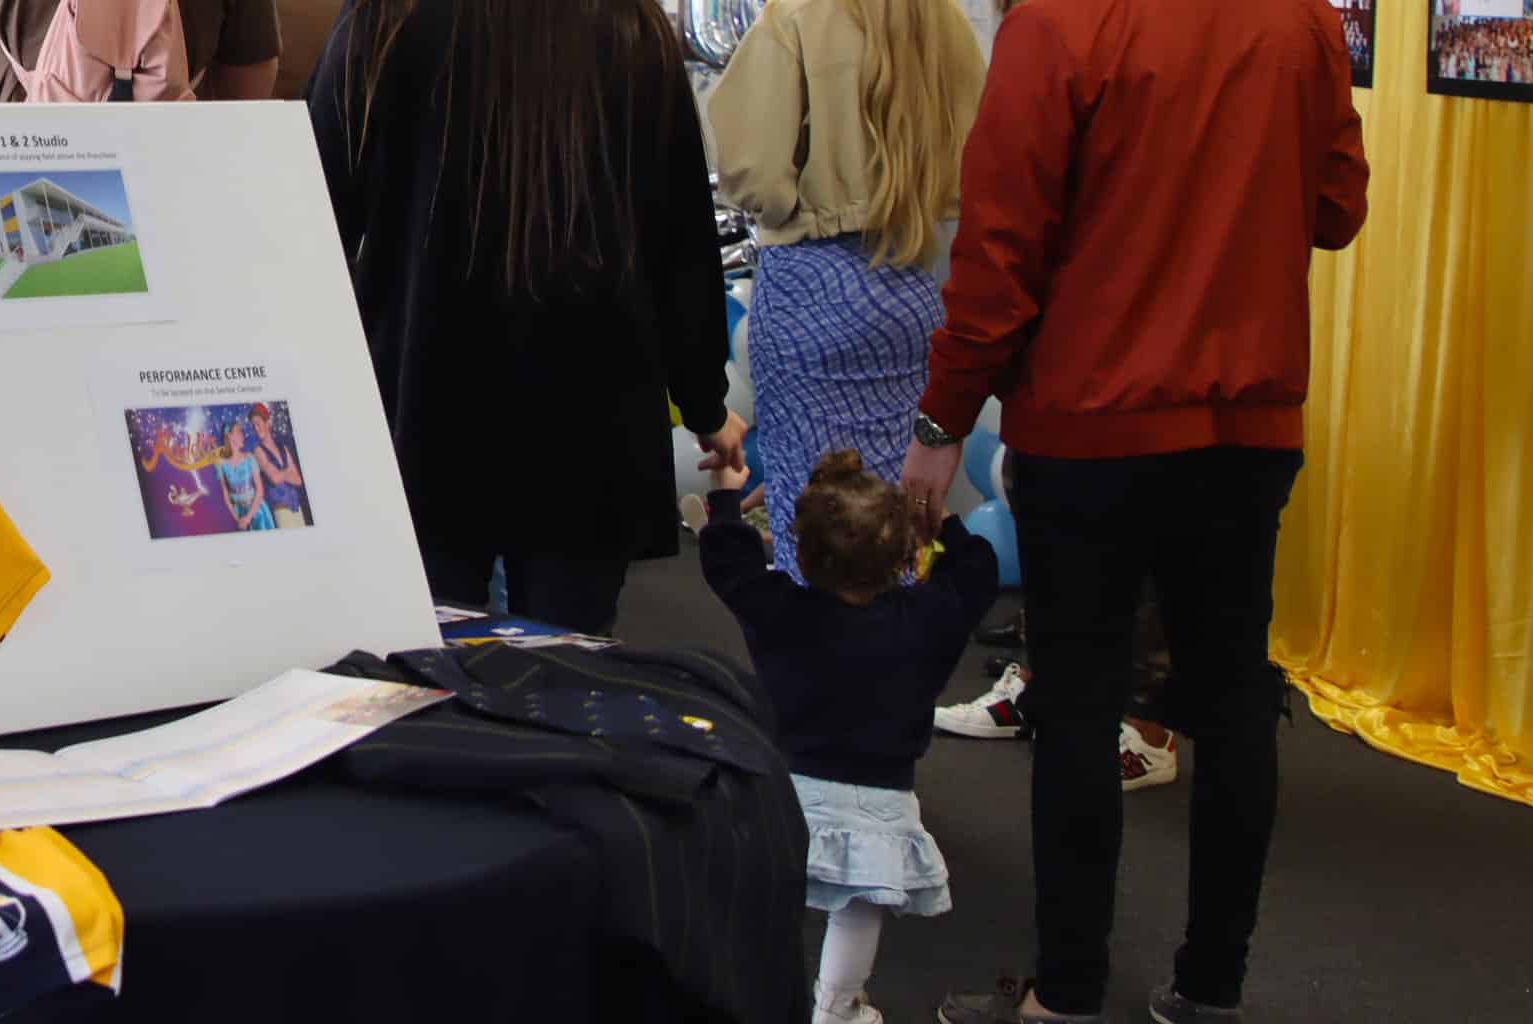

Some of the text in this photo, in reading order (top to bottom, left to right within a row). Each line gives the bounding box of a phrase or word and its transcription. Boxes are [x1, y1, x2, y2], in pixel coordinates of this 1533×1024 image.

[0, 135, 7, 148] 1
[10, 135, 19, 148] &
[22, 135, 29, 148] 2
[31, 134, 69, 147] Studio
[139, 366, 267, 384] PERFORMANCE CENTRE
